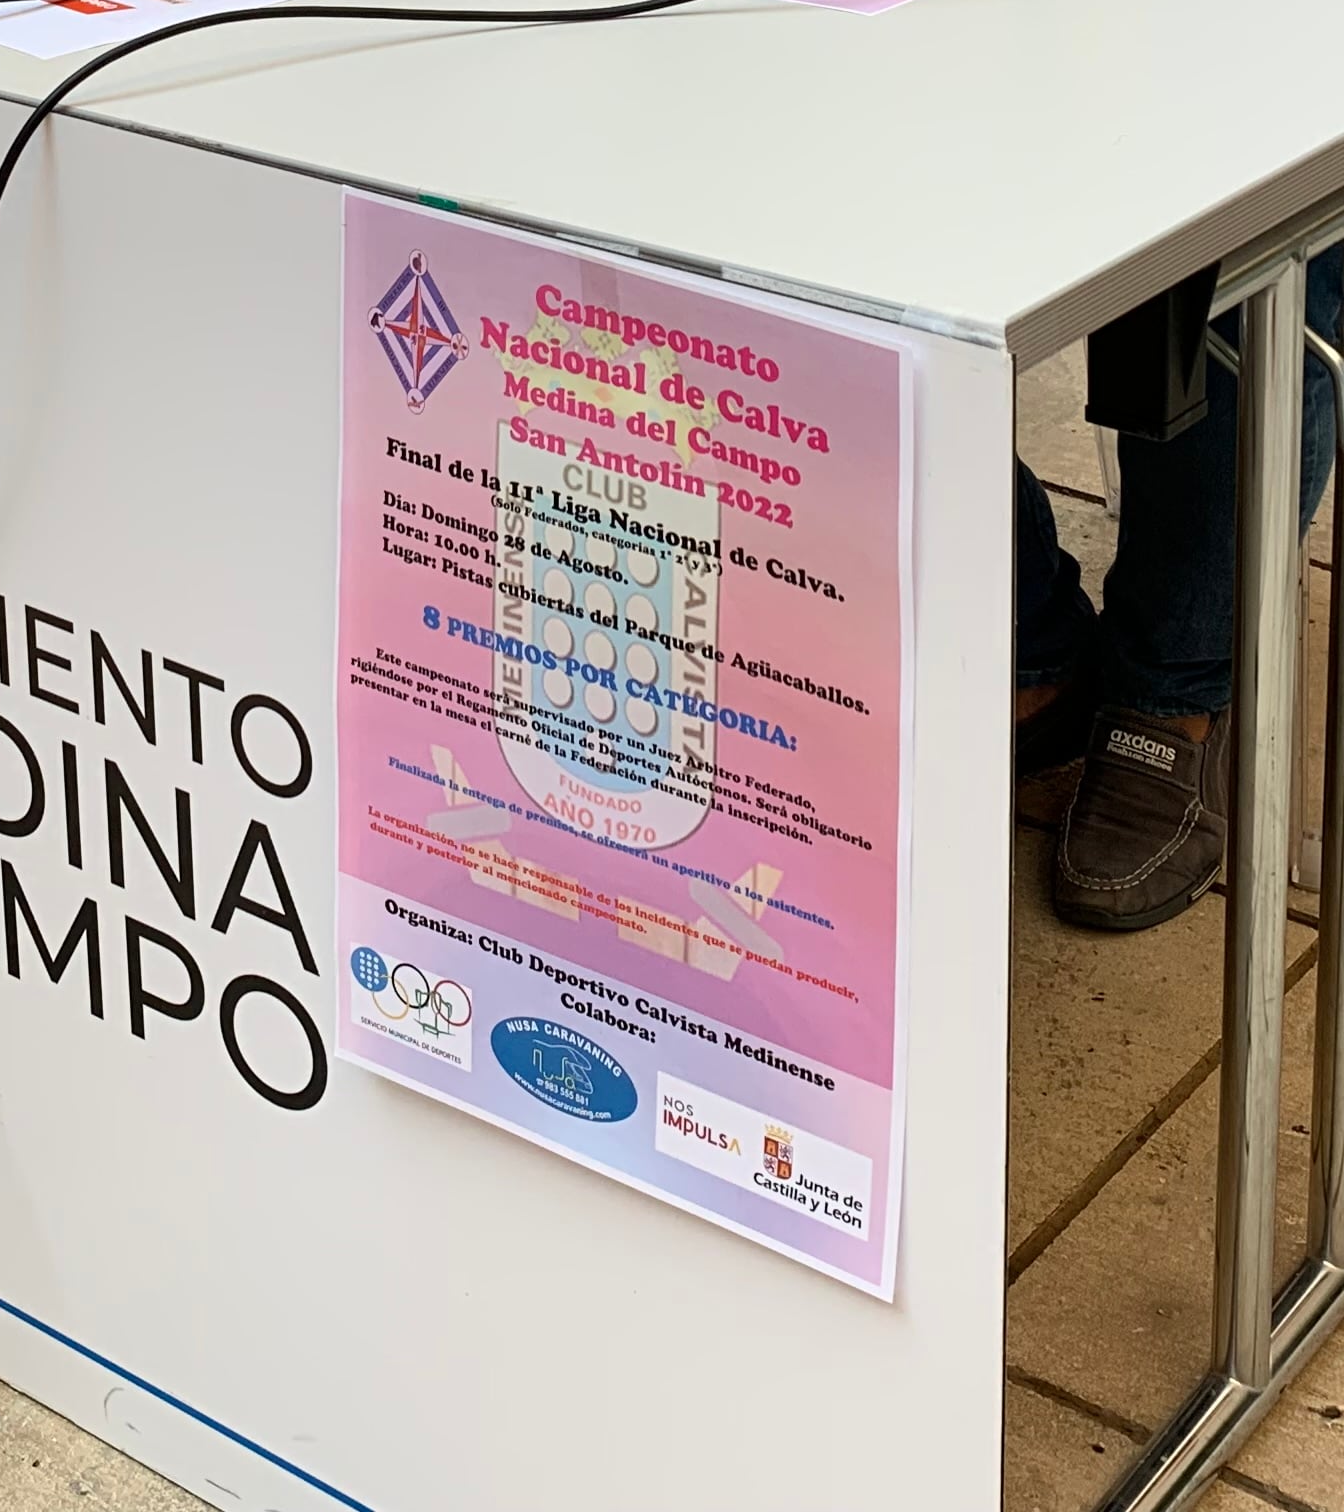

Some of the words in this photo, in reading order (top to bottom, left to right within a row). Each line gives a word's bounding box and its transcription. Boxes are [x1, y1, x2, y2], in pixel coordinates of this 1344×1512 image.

[535, 283, 779, 385] Campeonato
[479, 316, 646, 395] Nacional
[660, 369, 704, 412] de
[716, 386, 830, 454] Calva
[503, 371, 615, 429] Medina
[626, 408, 676, 447] del
[687, 424, 801, 489] Campo
[510, 414, 565, 456] San
[576, 434, 705, 498] Antolín
[717, 480, 793, 529] 2022
[386, 436, 441, 473] Final
[448, 457, 474, 483] de
[481, 468, 501, 492] la
[551, 490, 601, 525] Liga
[609, 507, 721, 560] Nacional
[729, 544, 758, 571] de
[766, 557, 845, 602] Calva.
[562, 461, 647, 512] CLUB
[383, 513, 429, 543] Hora:
[434, 532, 479, 560] 10.00
[484, 547, 501, 568] h.
[422, 503, 498, 543] Domingo
[504, 533, 525, 551] 28
[531, 540, 552, 560] de
[557, 551, 628, 586] Agosto.
[383, 537, 436, 569] Lugar:
[441, 557, 493, 588] Pistas
[498, 578, 583, 618] cubiertas
[590, 607, 618, 630] del
[625, 618, 694, 655] Parque
[701, 642, 725, 664] de
[731, 651, 869, 716] Agüacaballos.
[423, 604, 440, 631] 8
[447, 616, 556, 671] PREMIOS
[565, 655, 617, 691] POR
[351, 656, 412, 687] rigiéndose
[416, 681, 437, 697] por
[441, 688, 452, 701] el
[456, 693, 527, 728] Regamento
[531, 719, 574, 744] Oficial
[578, 736, 594, 752] de
[598, 742, 660, 774] Deportes
[665, 765, 751, 806] Autóctonos.
[755, 797, 786, 819] Será
[792, 811, 872, 851] obligatorio
[351, 673, 409, 702] presentar
[412, 695, 427, 709] en
[430, 700, 441, 713] la
[445, 707, 476, 726] mesa
[480, 718, 491, 731] el
[495, 724, 530, 745] carné
[535, 737, 550, 753] de
[554, 744, 566, 758] la
[571, 750, 646, 785] Federación
[651, 777, 706, 806] durante
[711, 798, 723, 813] la
[728, 805, 812, 845] inscripción.
[376, 647, 401, 667] Este
[404, 660, 480, 695] campeonato
[514, 699, 594, 735] supervisado
[598, 726, 622, 745] por
[627, 736, 644, 751] un
[649, 741, 681, 764] Juez
[745, 775, 815, 813] Federado,
[543, 793, 594, 829] AÑO
[604, 817, 656, 842] 1970
[560, 773, 641, 811] FUNDADO
[385, 897, 472, 946] Organiza:
[478, 934, 523, 966] Club
[529, 954, 628, 1009] Deportivo
[635, 996, 717, 1044] Calvista
[724, 1032, 835, 1092] Medinense
[560, 991, 655, 1043] Colabora:
[361, 1016, 388, 1033] SERVICIO
[388, 1028, 420, 1048] MUNICIPAL
[421, 1042, 430, 1052] DE
[431, 1046, 462, 1065] DEPORTES
[506, 1019, 539, 1034] NUSA
[544, 1023, 623, 1078] CARAVANING
[664, 1094, 693, 1117] NOS
[754, 1171, 806, 1206] Castilla
[810, 1198, 819, 1214] y
[824, 1201, 861, 1230] León
[795, 1172, 839, 1202] Junta
[843, 1192, 862, 1212] de
